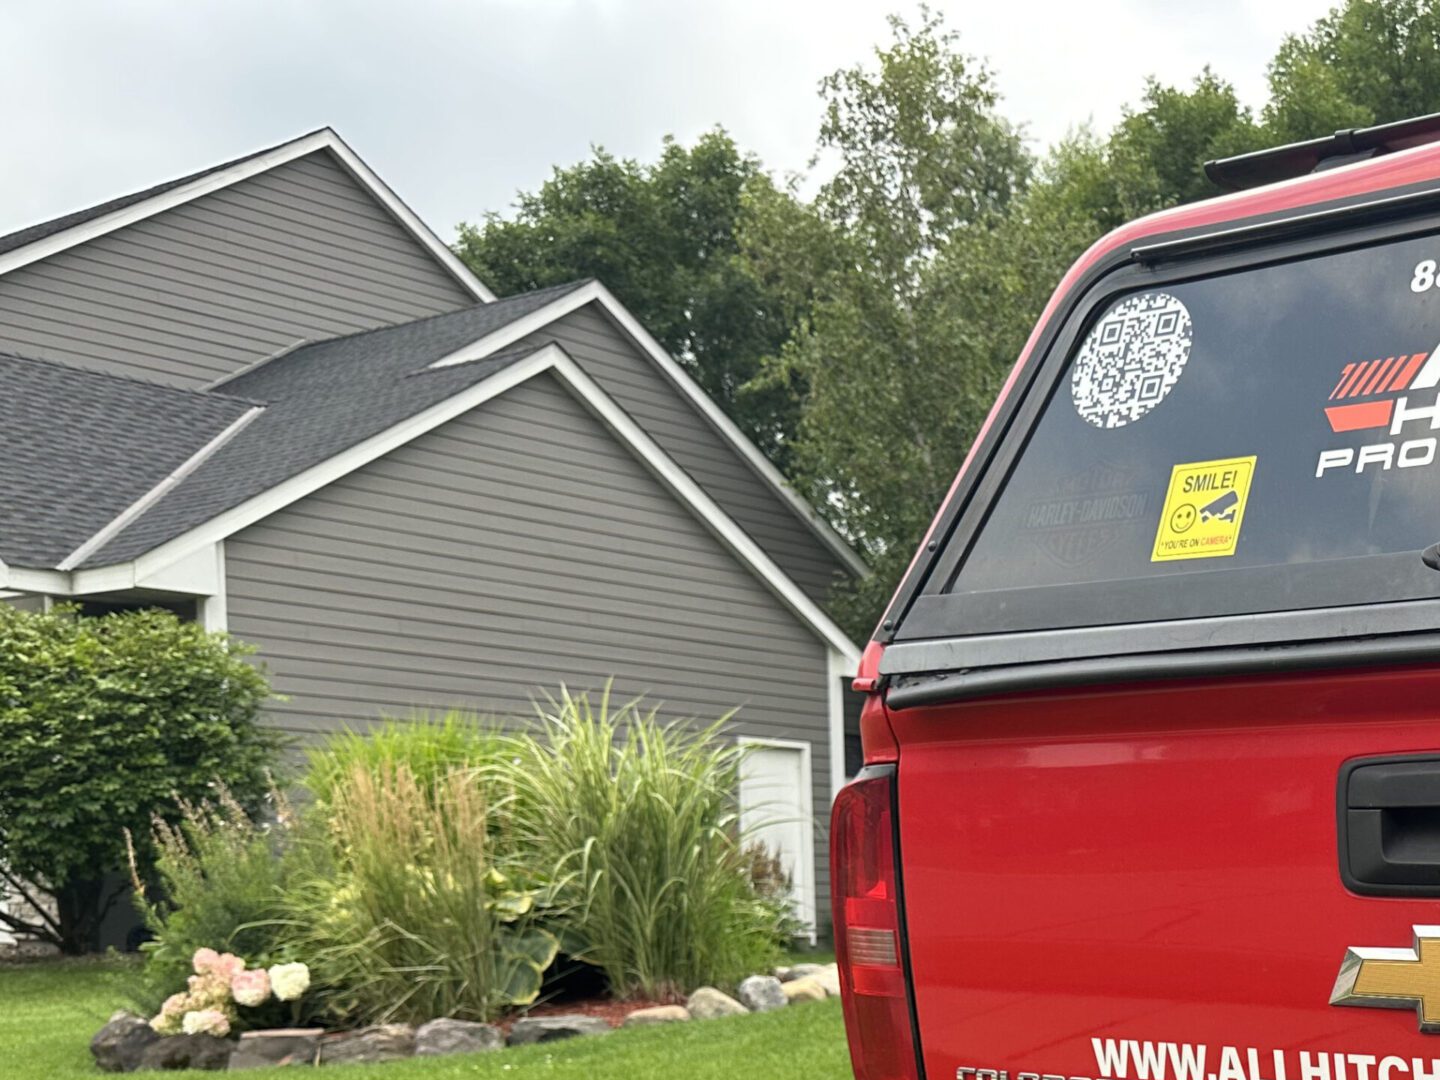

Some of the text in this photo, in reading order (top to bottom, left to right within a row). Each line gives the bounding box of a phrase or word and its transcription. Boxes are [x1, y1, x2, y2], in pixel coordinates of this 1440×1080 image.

[1183, 471, 1238, 493] SMILE!
[1026, 493, 1149, 529] HARLEY-DAVIDSON
[1189, 538, 1199, 548] ON
